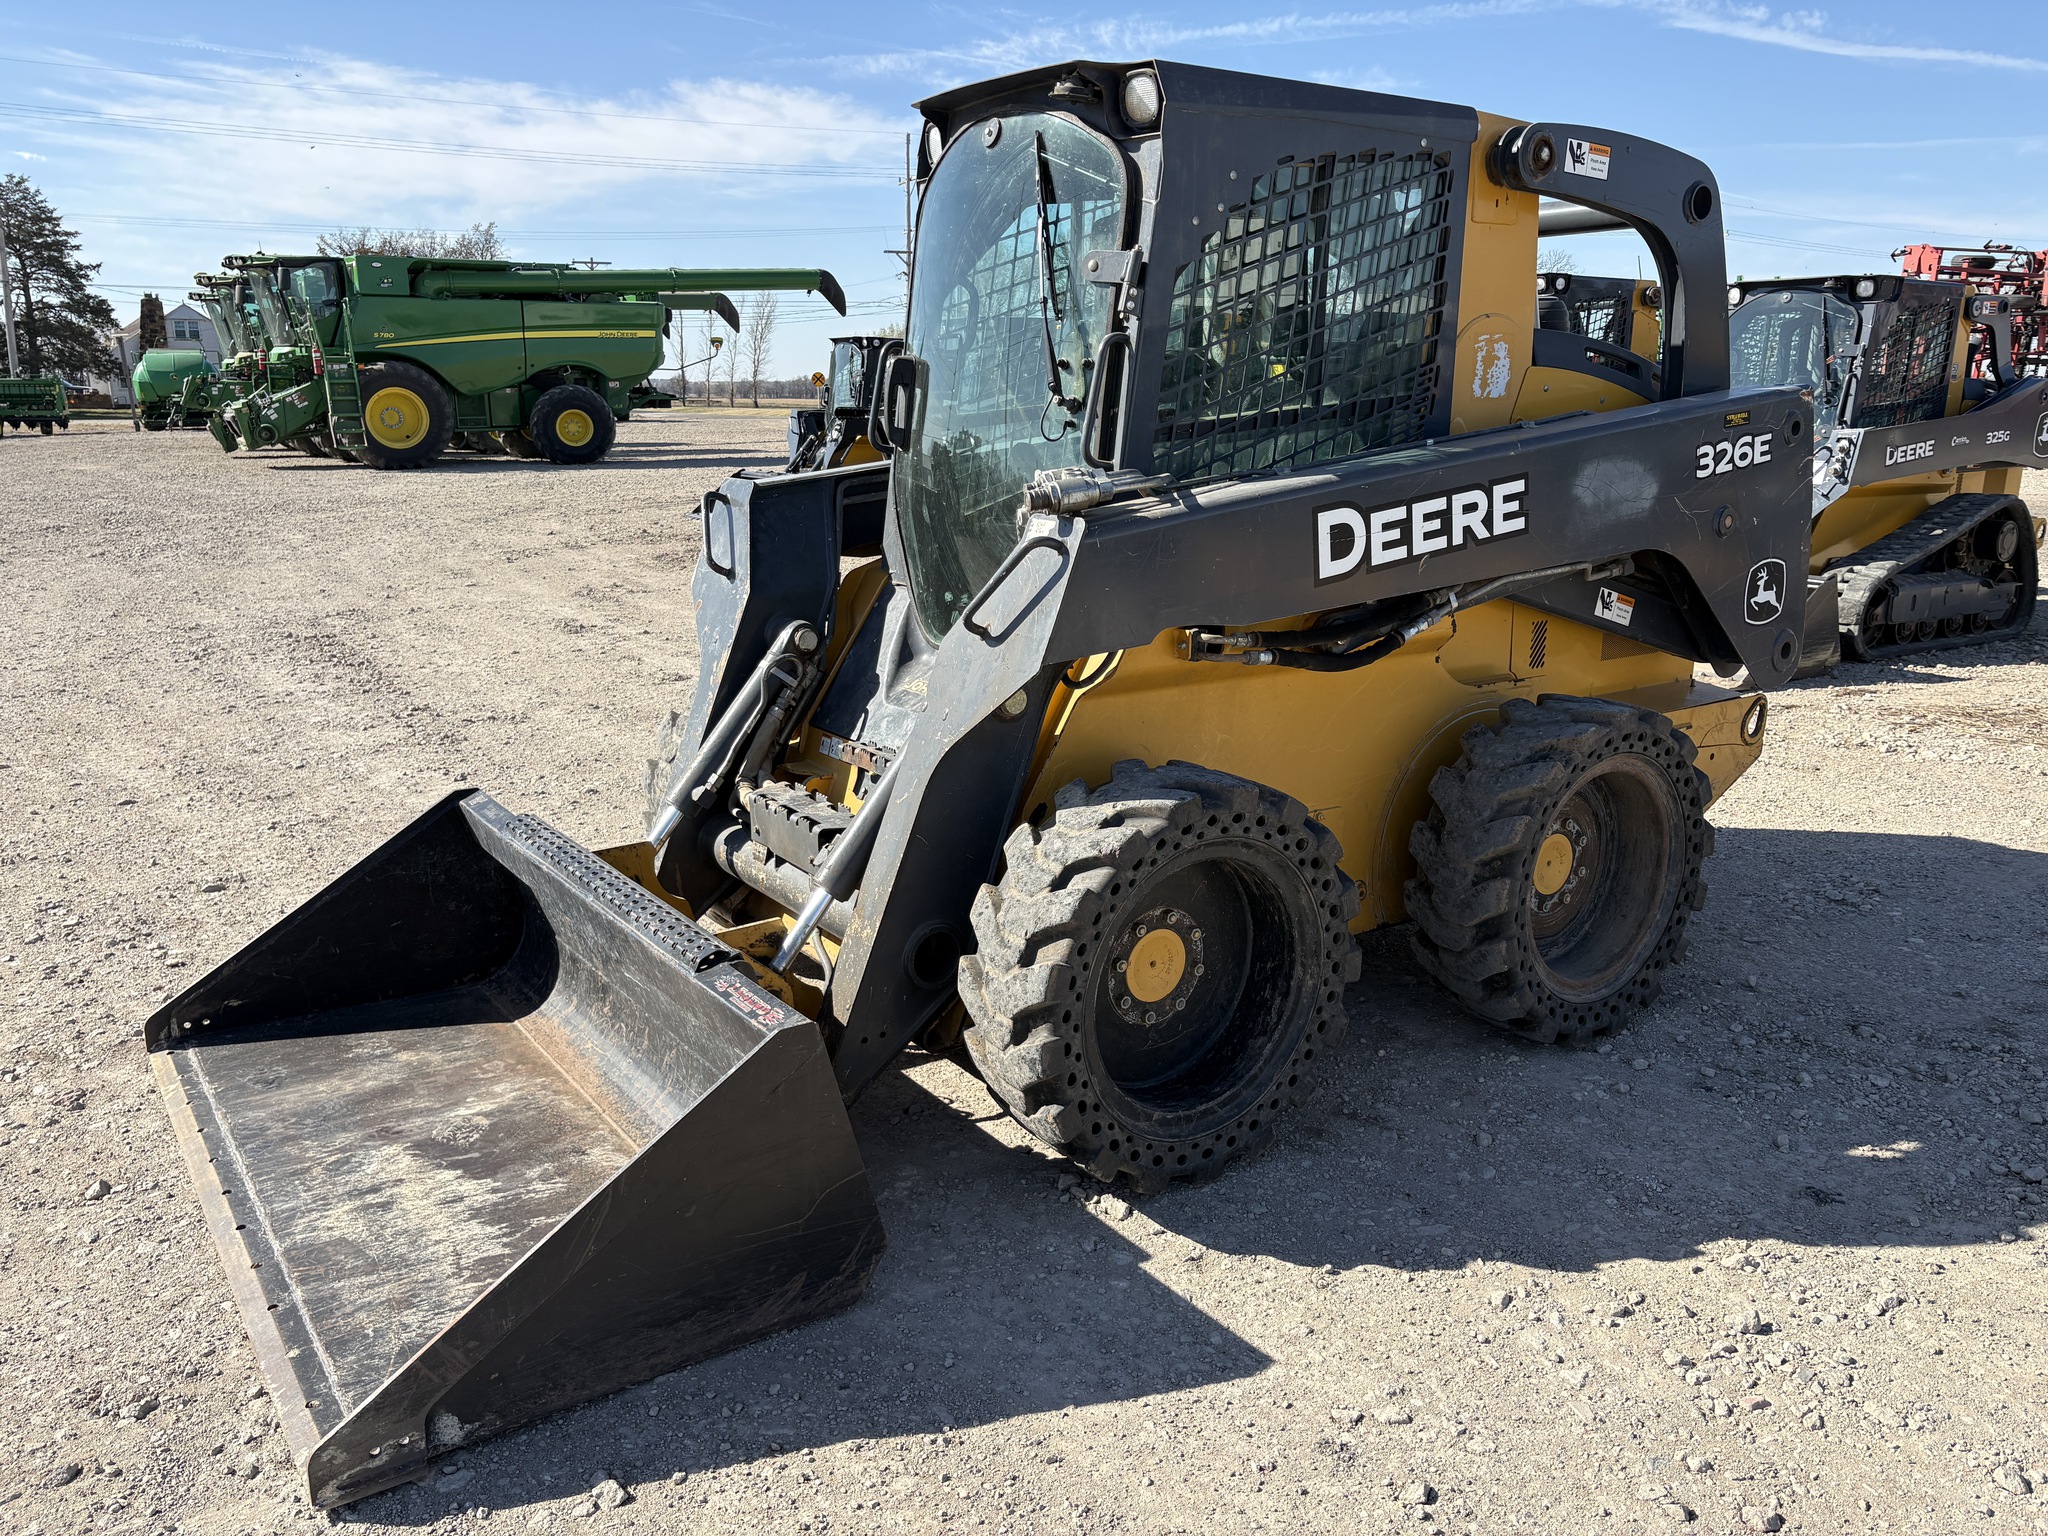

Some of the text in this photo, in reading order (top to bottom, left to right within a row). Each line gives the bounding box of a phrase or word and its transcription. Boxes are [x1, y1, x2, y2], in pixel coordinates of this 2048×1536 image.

[1885, 439, 1935, 466] DEERE
[1985, 430, 2011, 444] 325G
[1696, 433, 1772, 478] 326E
[1317, 479, 1526, 580] DEERE
